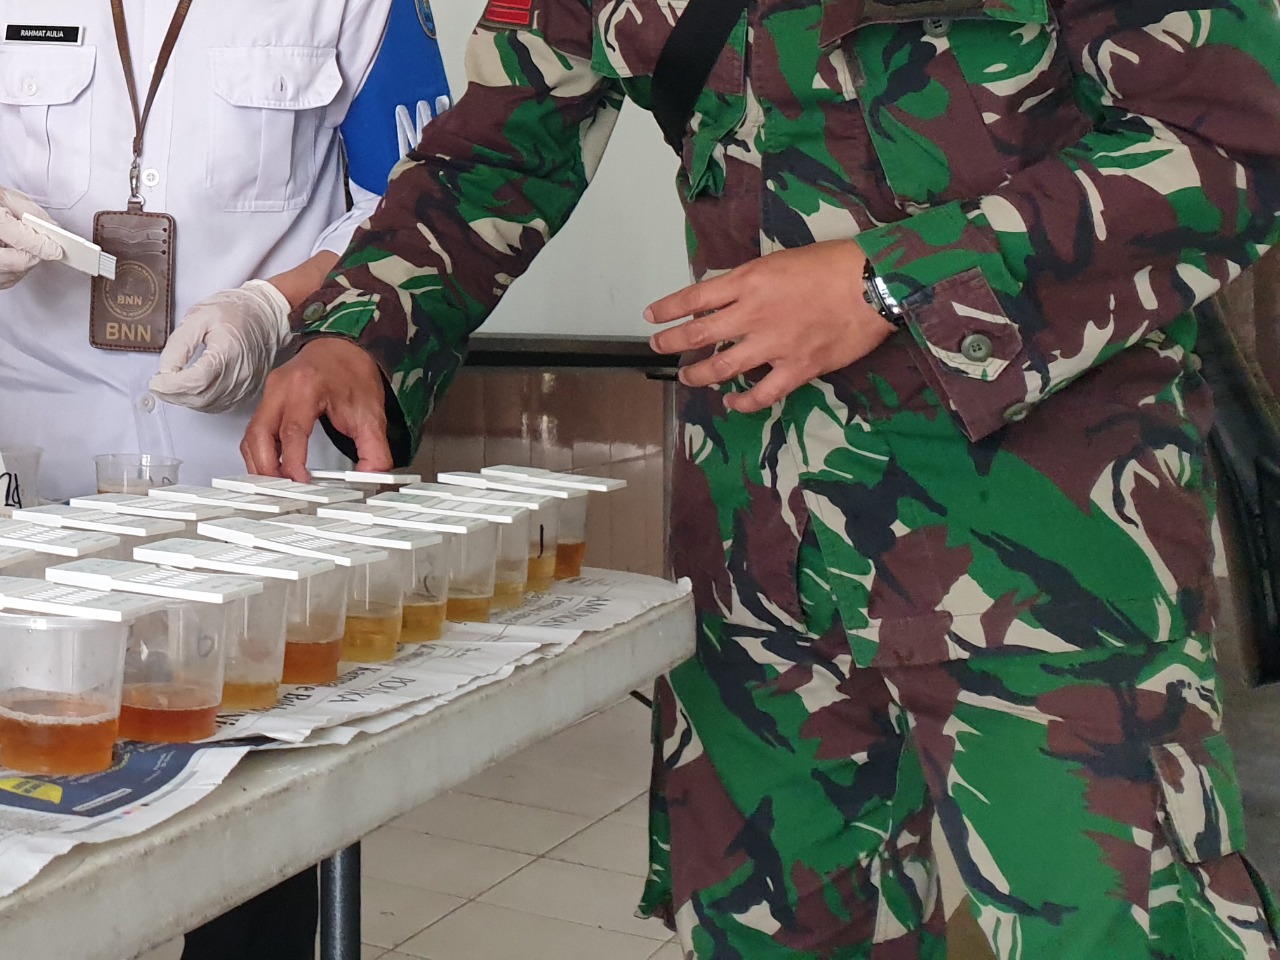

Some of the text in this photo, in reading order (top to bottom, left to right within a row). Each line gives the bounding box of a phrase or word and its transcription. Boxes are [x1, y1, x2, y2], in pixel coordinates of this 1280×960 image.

[20, 29, 64, 38] RAHMAT AULIA
[117, 295, 143, 306] BNN
[106, 321, 152, 343] BNN
